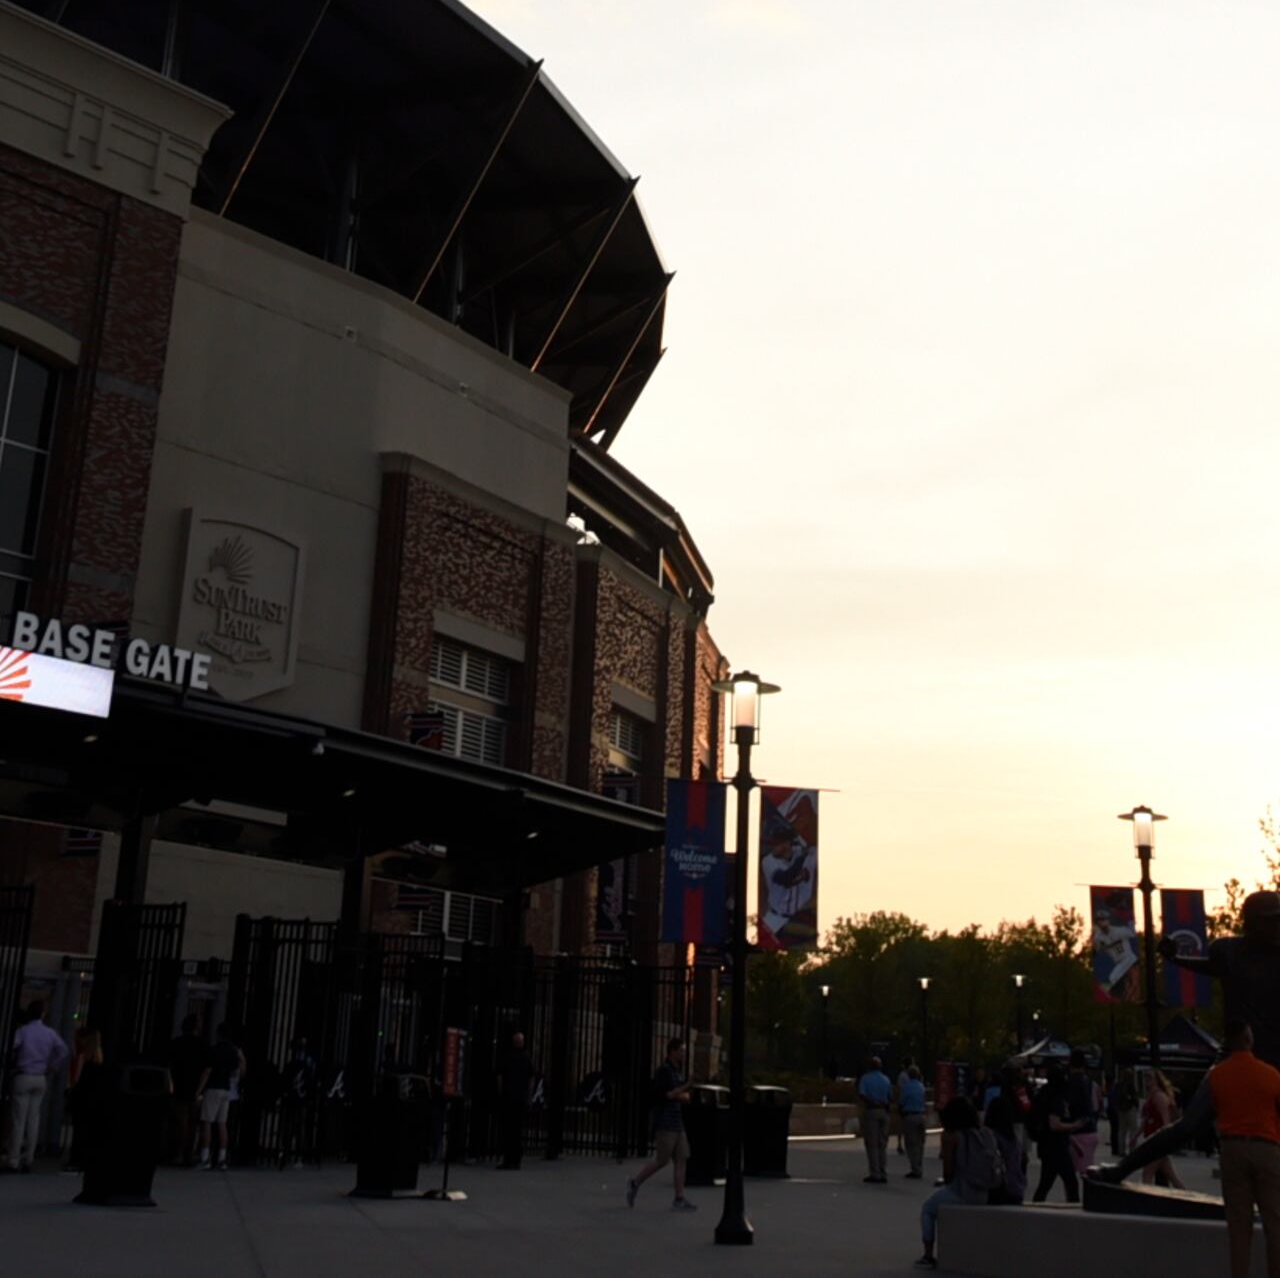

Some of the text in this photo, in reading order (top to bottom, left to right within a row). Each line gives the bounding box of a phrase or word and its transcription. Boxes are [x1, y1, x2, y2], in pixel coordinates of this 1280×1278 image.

[12, 610, 116, 670] BASE
[124, 637, 213, 692] GATE
[213, 608, 262, 646] PARK
